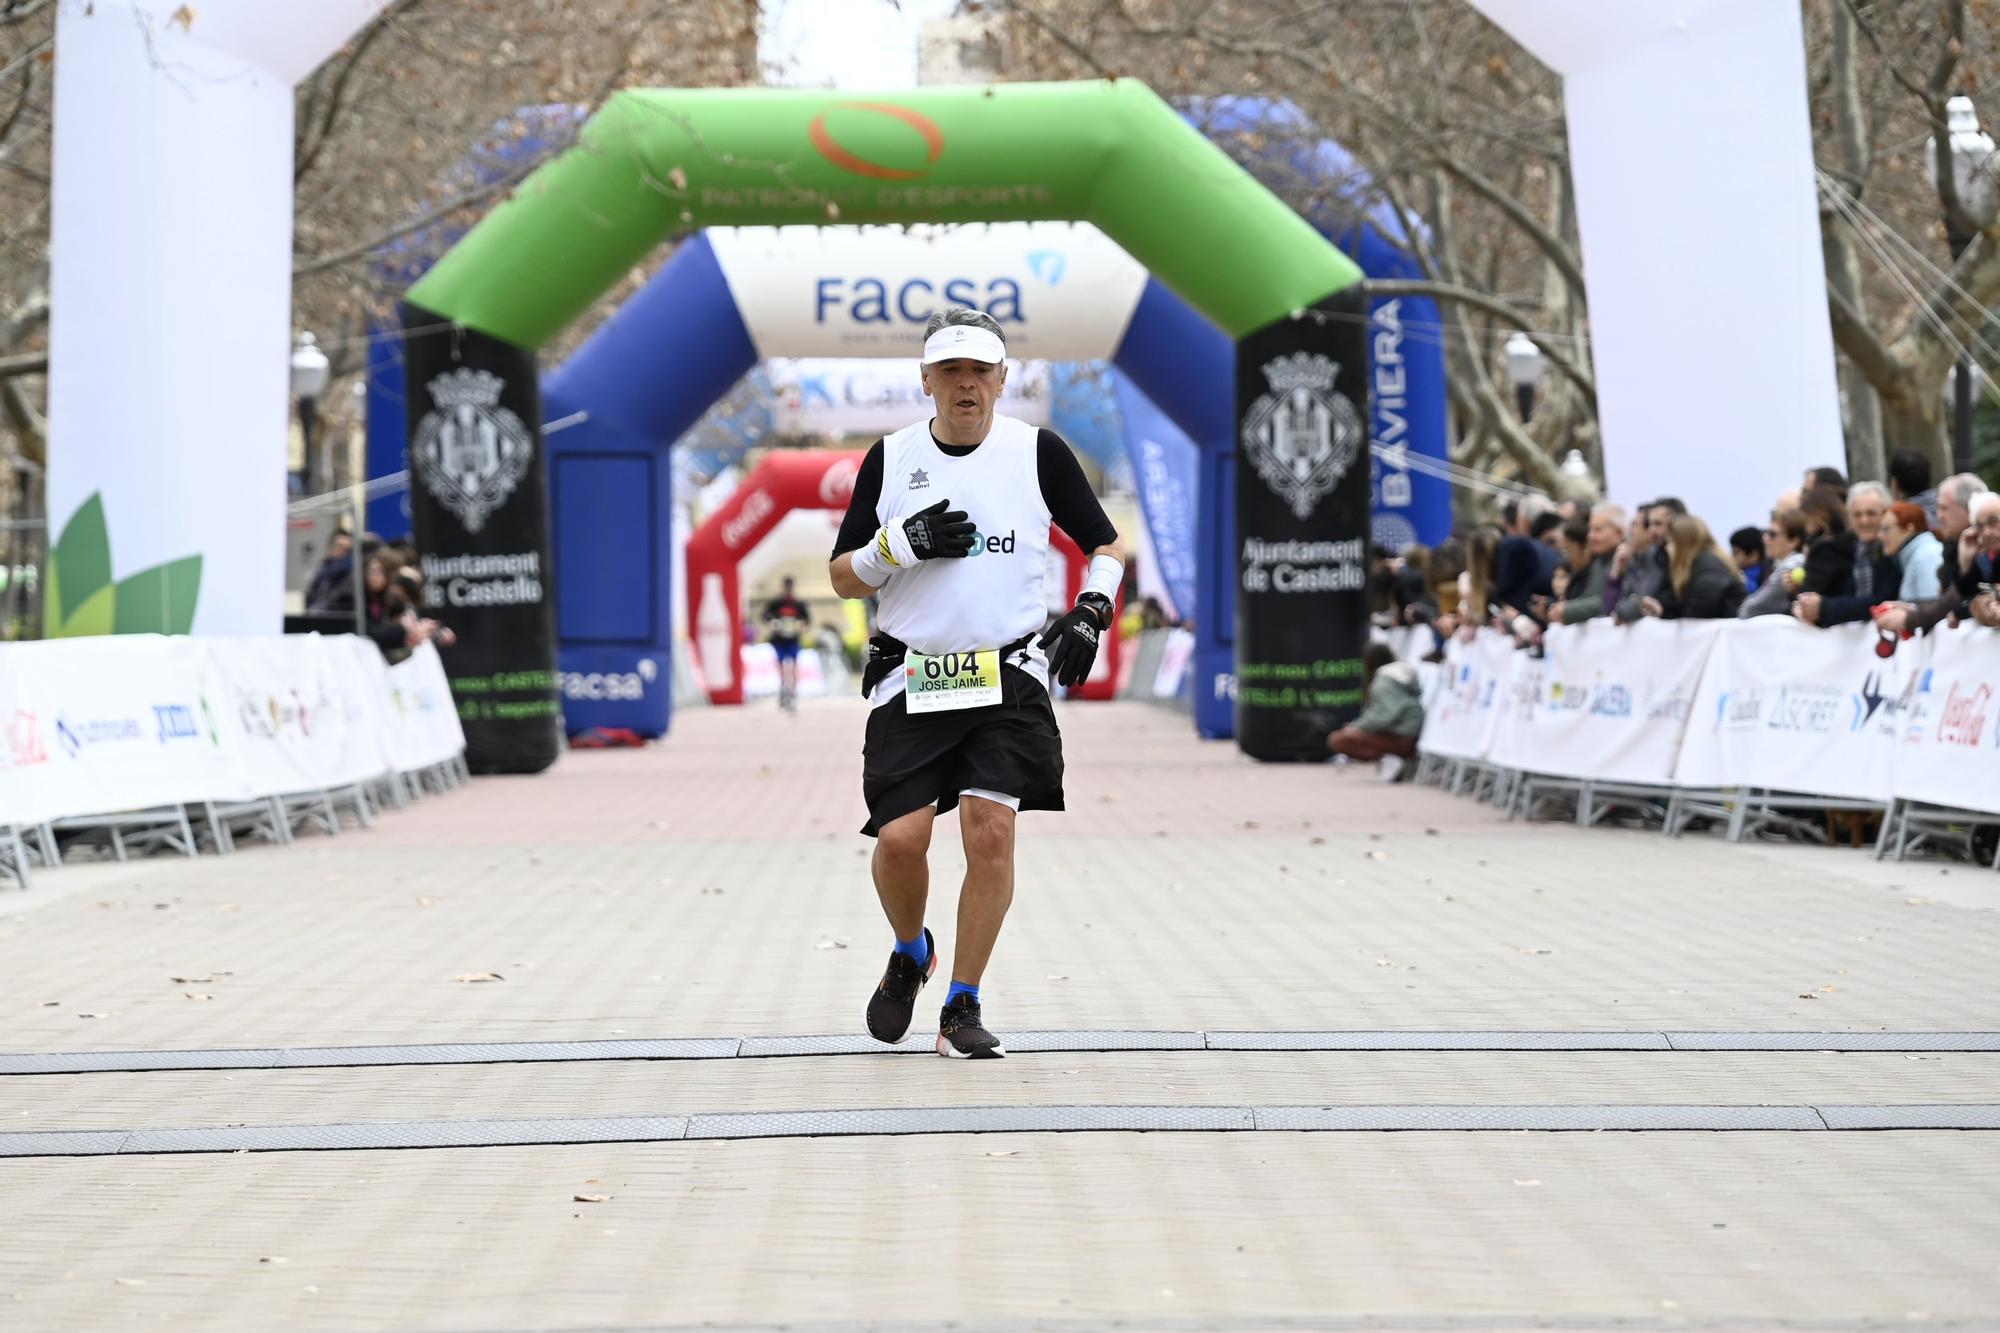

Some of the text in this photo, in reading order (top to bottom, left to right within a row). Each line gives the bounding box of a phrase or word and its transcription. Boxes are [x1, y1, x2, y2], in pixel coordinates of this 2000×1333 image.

[702, 187, 864, 209] PATRON
[1373, 299, 1412, 507] BAVIERA
[908, 482, 930, 491] luanvi
[1242, 537, 1364, 566] Ajuntament
[1243, 566, 1270, 592] de
[924, 653, 979, 679] 604
[919, 677, 987, 692] JOSE JAIME
